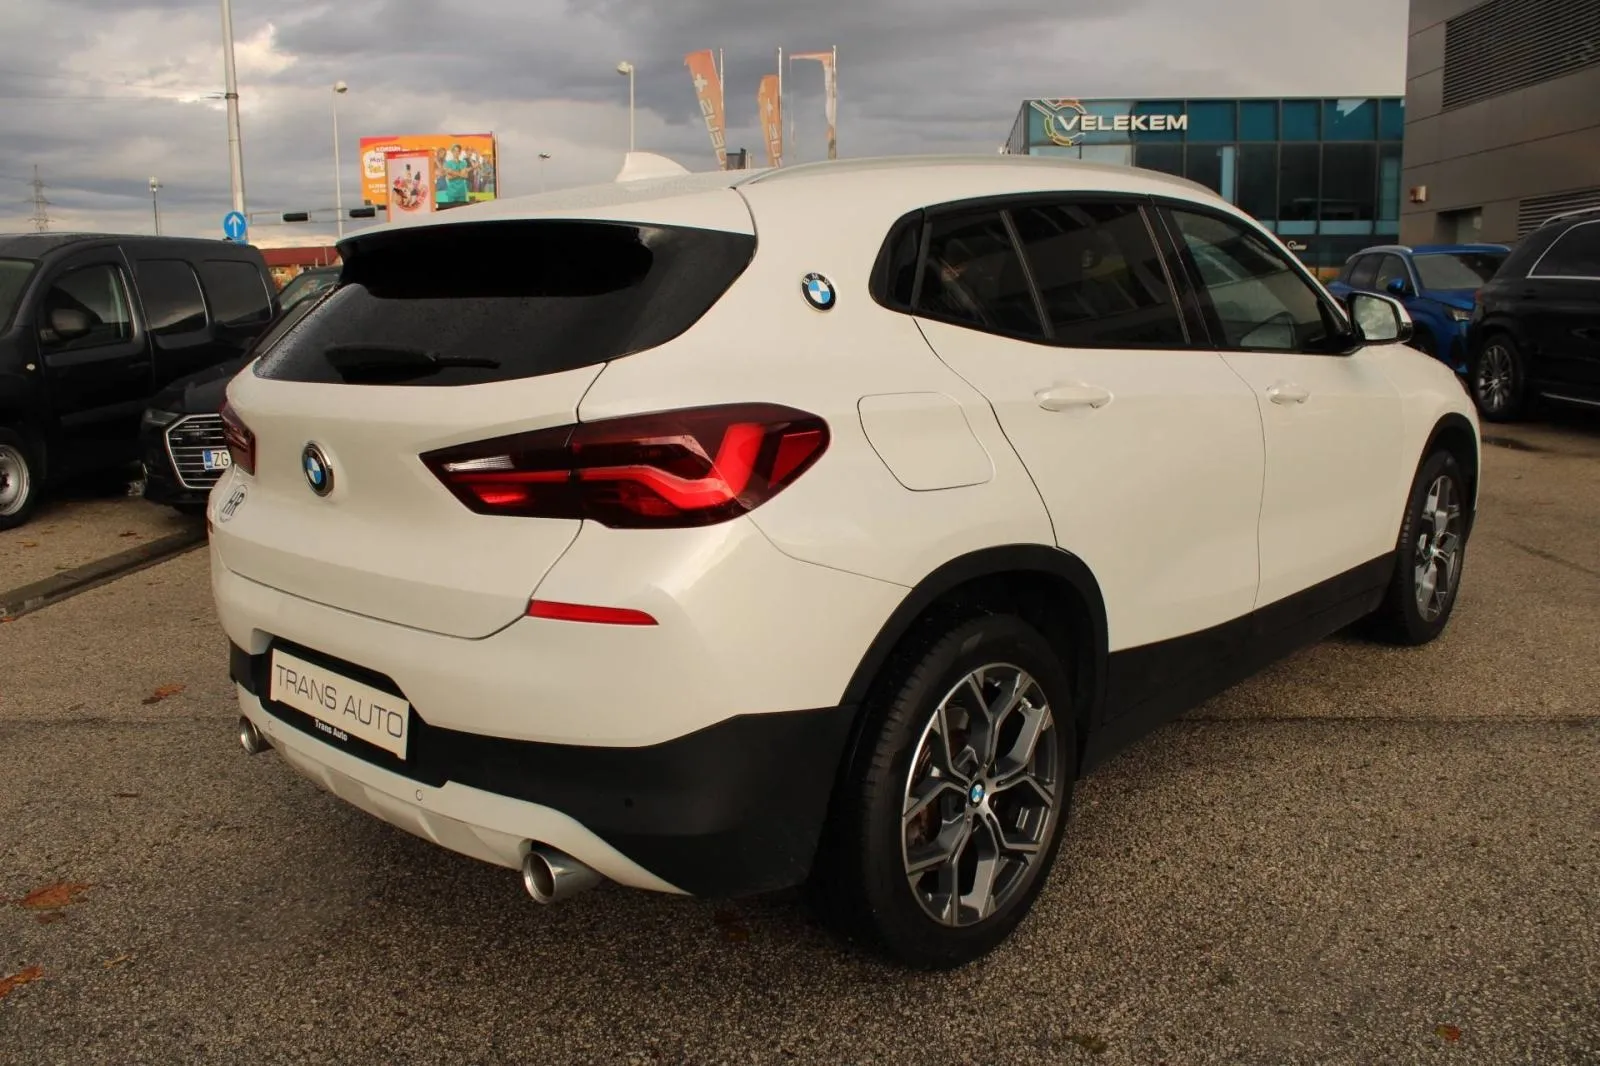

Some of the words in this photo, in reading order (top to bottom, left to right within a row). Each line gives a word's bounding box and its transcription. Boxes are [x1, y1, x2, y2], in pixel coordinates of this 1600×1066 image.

[1058, 115, 1188, 130] VELEKEM
[222, 491, 245, 516] HR
[276, 664, 337, 710] TRANS
[343, 695, 404, 739] AUTO
[314, 718, 332, 735] Trans
[332, 727, 348, 742] Auto
